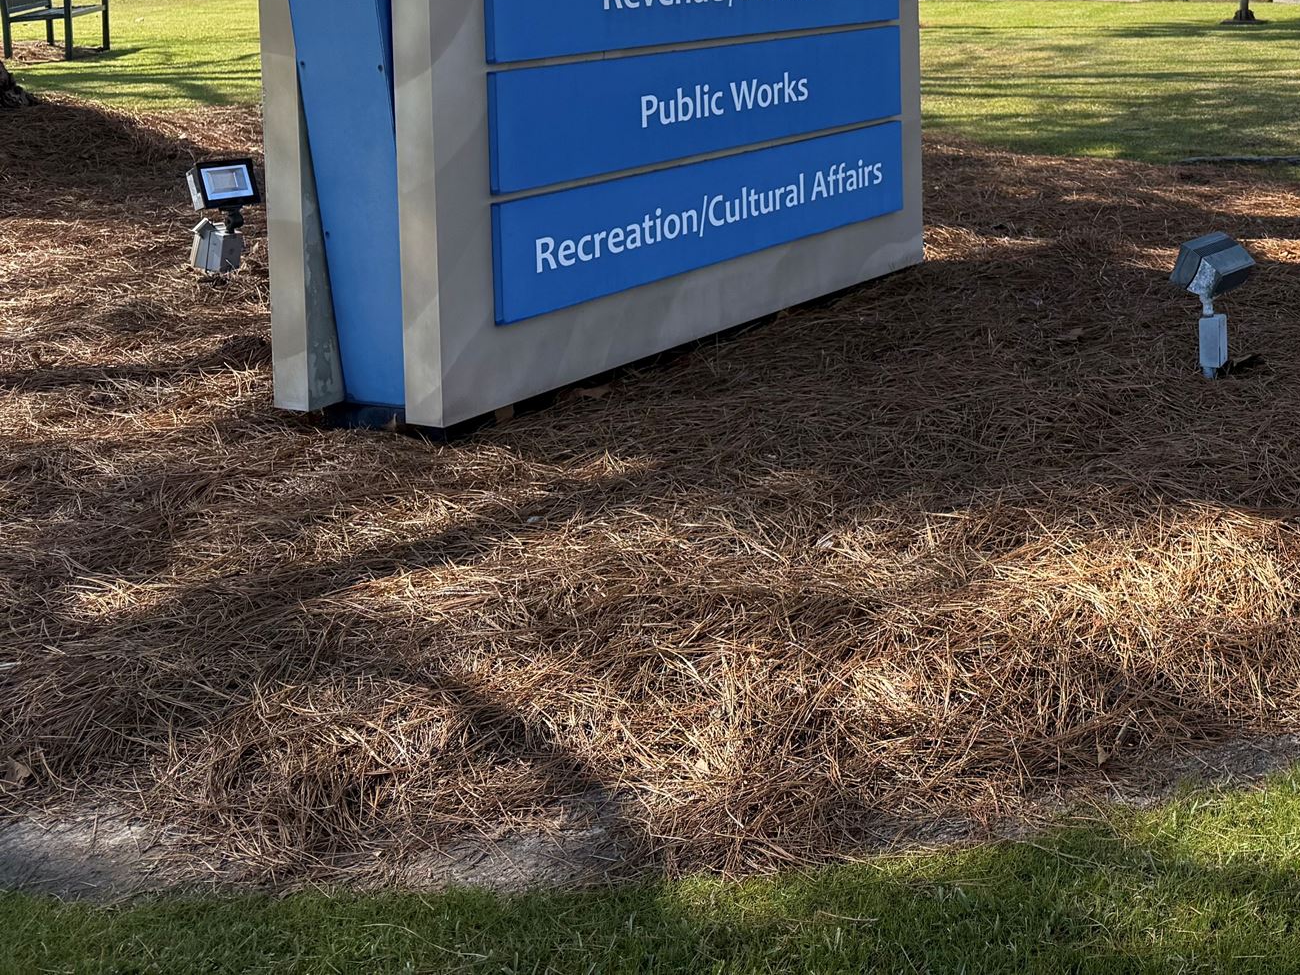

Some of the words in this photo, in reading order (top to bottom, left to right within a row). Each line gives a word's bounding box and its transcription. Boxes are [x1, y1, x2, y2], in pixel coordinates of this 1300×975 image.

[641, 84, 724, 128] Public
[730, 72, 809, 112] Works
[536, 173, 805, 274] Recreation/Cultural
[811, 159, 883, 201] Affairs
